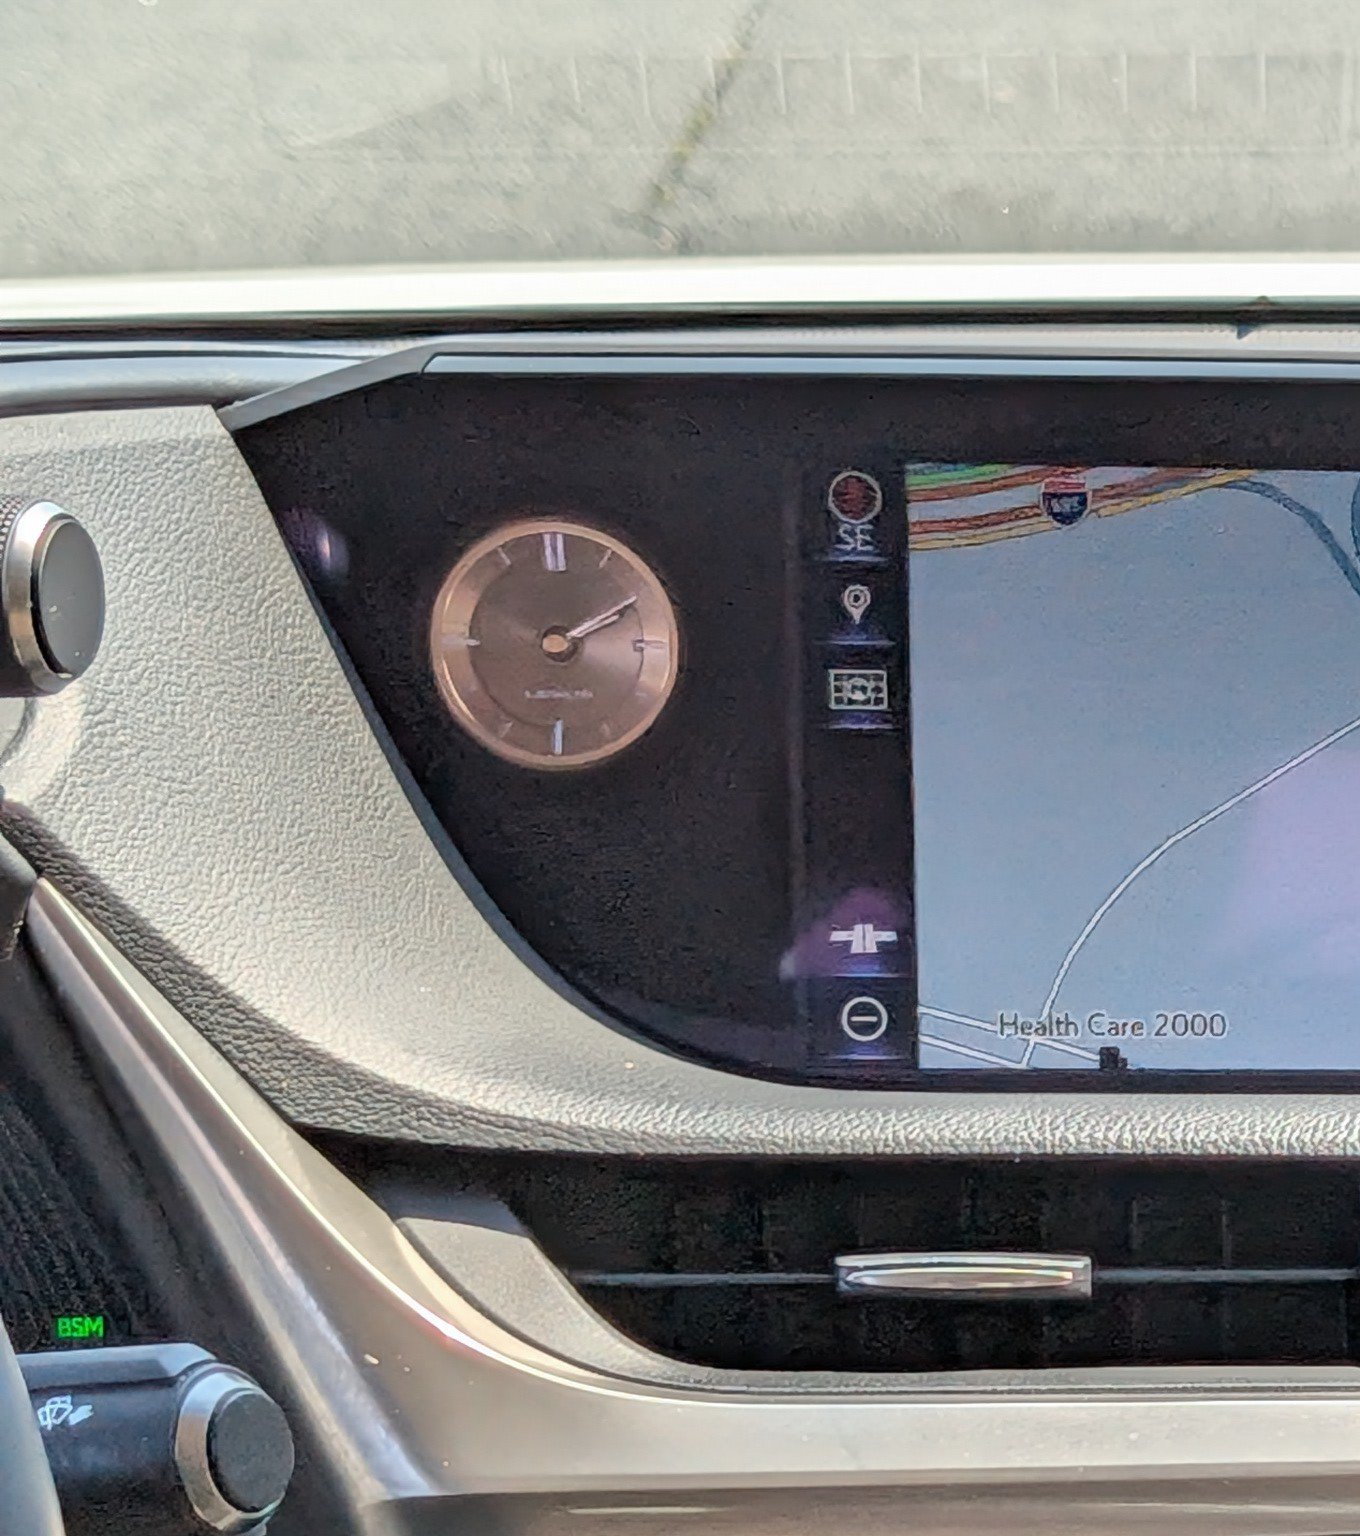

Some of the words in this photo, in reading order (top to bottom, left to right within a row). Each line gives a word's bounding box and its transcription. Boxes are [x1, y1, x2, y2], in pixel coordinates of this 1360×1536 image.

[836, 523, 877, 552] SE
[999, 1013, 1078, 1037] Health
[1088, 1013, 1144, 1037] Care
[1155, 1013, 1227, 1037] 2000
[59, 1316, 103, 1337] BSM
